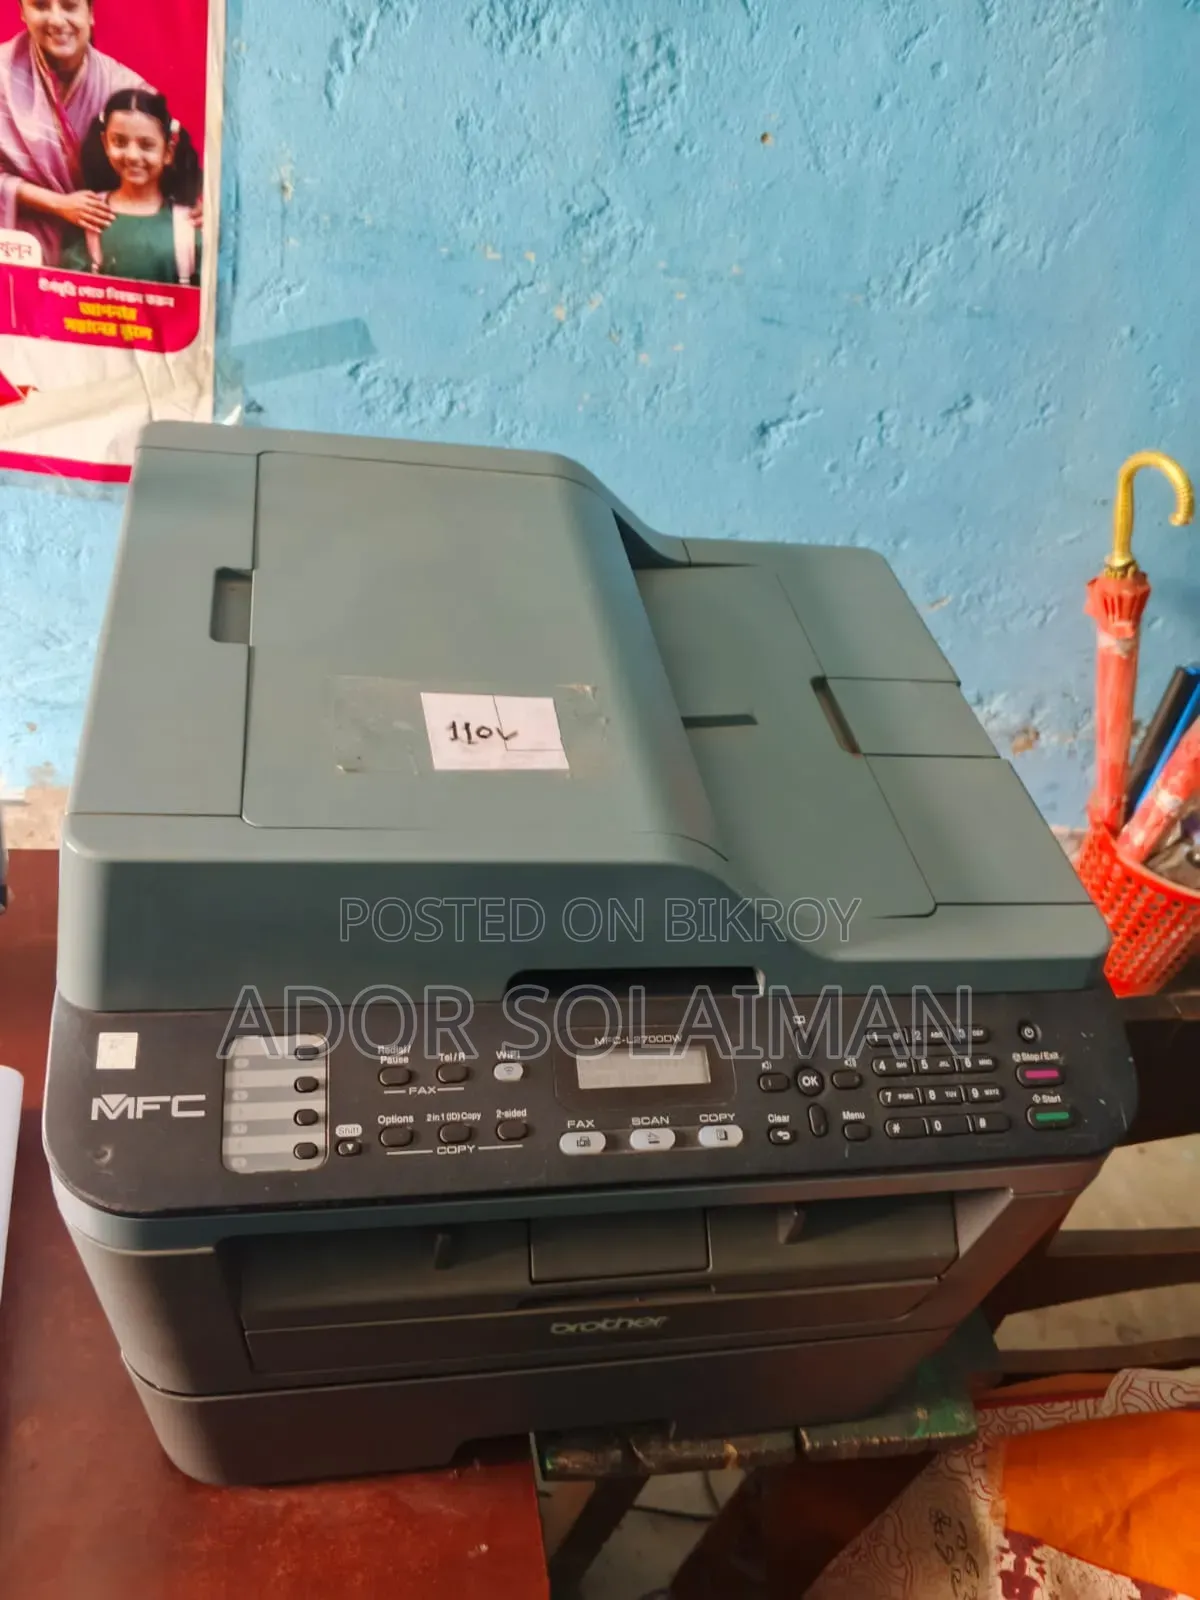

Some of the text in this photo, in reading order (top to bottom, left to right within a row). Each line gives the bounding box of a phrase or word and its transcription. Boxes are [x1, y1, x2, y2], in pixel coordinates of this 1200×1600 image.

[380, 1055, 409, 1065] Pause
[802, 1075, 819, 1087] OK
[408, 1086, 437, 1095] FAX
[971, 1088, 979, 1098] 9
[885, 1091, 892, 1103] 7
[91, 1093, 206, 1121] MFC
[377, 1114, 414, 1126] Options
[699, 1112, 736, 1123] COPY
[767, 1113, 790, 1123] Clear
[842, 1110, 865, 1120] Menu
[567, 1119, 595, 1129] FAX
[631, 1115, 670, 1126] SCAN
[437, 1145, 476, 1155] COPY
[551, 1315, 669, 1334] brother
